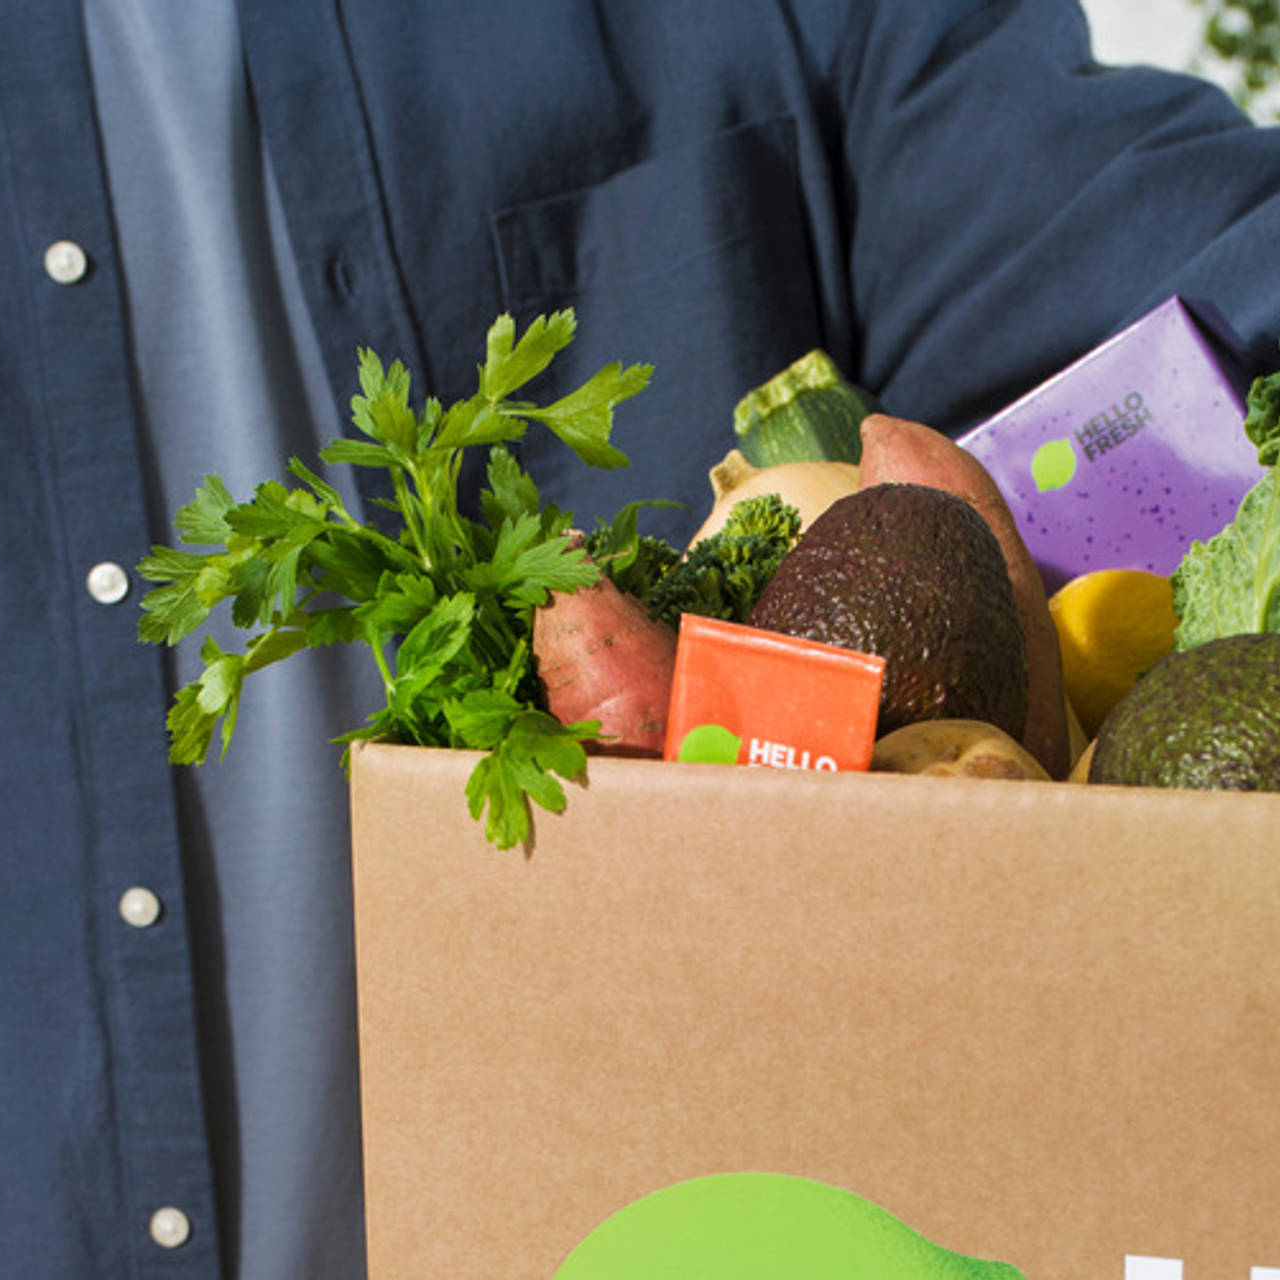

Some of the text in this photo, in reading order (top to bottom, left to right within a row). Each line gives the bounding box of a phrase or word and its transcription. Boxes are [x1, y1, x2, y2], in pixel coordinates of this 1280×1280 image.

[1074, 391, 1143, 445] HELLO
[1083, 407, 1153, 462] FRESH
[749, 738, 837, 771] HELLO
